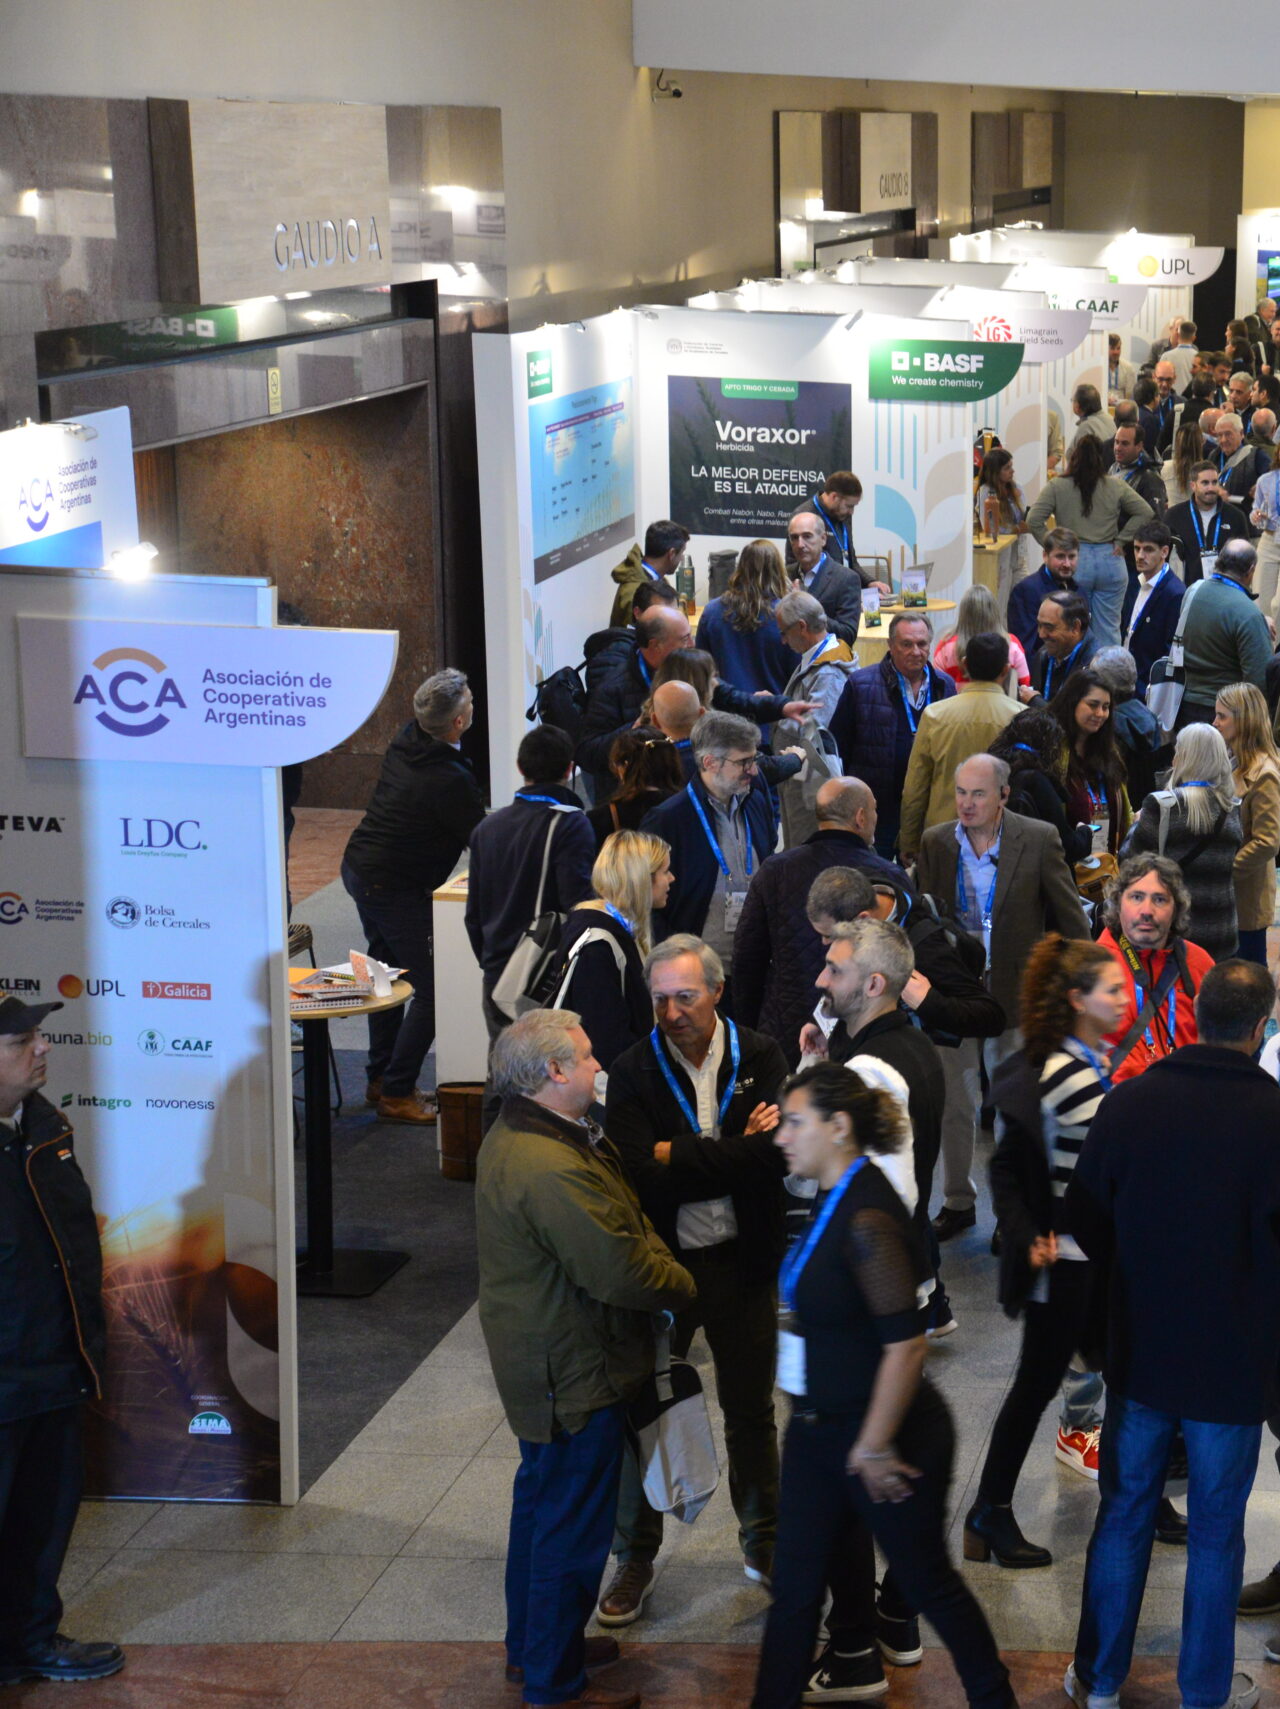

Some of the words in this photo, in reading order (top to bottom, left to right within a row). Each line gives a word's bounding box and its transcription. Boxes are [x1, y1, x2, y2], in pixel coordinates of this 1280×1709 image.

[274, 217, 361, 272] GAUDIO
[368, 216, 382, 260] A
[1161, 258, 1196, 276] UPL
[1075, 299, 1120, 313] CAAF
[986, 326, 1001, 342] LG
[1019, 327, 1058, 337] Limagrain
[1019, 336, 1039, 344] Field
[1040, 336, 1064, 346] Seeds
[923, 352, 984, 373] BASF
[724, 383, 742, 391] APTO
[742, 384, 762, 392] TRIGO
[769, 385, 795, 393] CEBADA
[891, 375, 907, 385] We
[908, 377, 937, 387] create
[938, 378, 984, 390] chemistry
[715, 442, 755, 452] Herbicida
[89, 456, 98, 470] de
[691, 465, 708, 478] LA
[711, 466, 759, 480] MEJOR
[762, 469, 826, 483] DEFENSA
[714, 481, 732, 493] ES
[735, 482, 752, 494] EL
[754, 483, 808, 497] ATAQUE
[202, 668, 305, 688] Asociación
[309, 672, 332, 688] de
[73, 670, 187, 714] ACA
[203, 687, 327, 709] Cooperativas
[204, 707, 306, 729] Argentinas
[145, 905, 176, 917] Bolsa
[144, 918, 160, 928] de
[162, 919, 211, 930] Cereales
[0, 978, 41, 992] KLEIN
[86, 979, 126, 997] UPL
[164, 984, 208, 998] Galicia
[171, 1039, 213, 1052] CAAF
[78, 1094, 132, 1110] intagro
[145, 1098, 215, 1110] novonesis
[193, 1418, 229, 1428] SEMA
